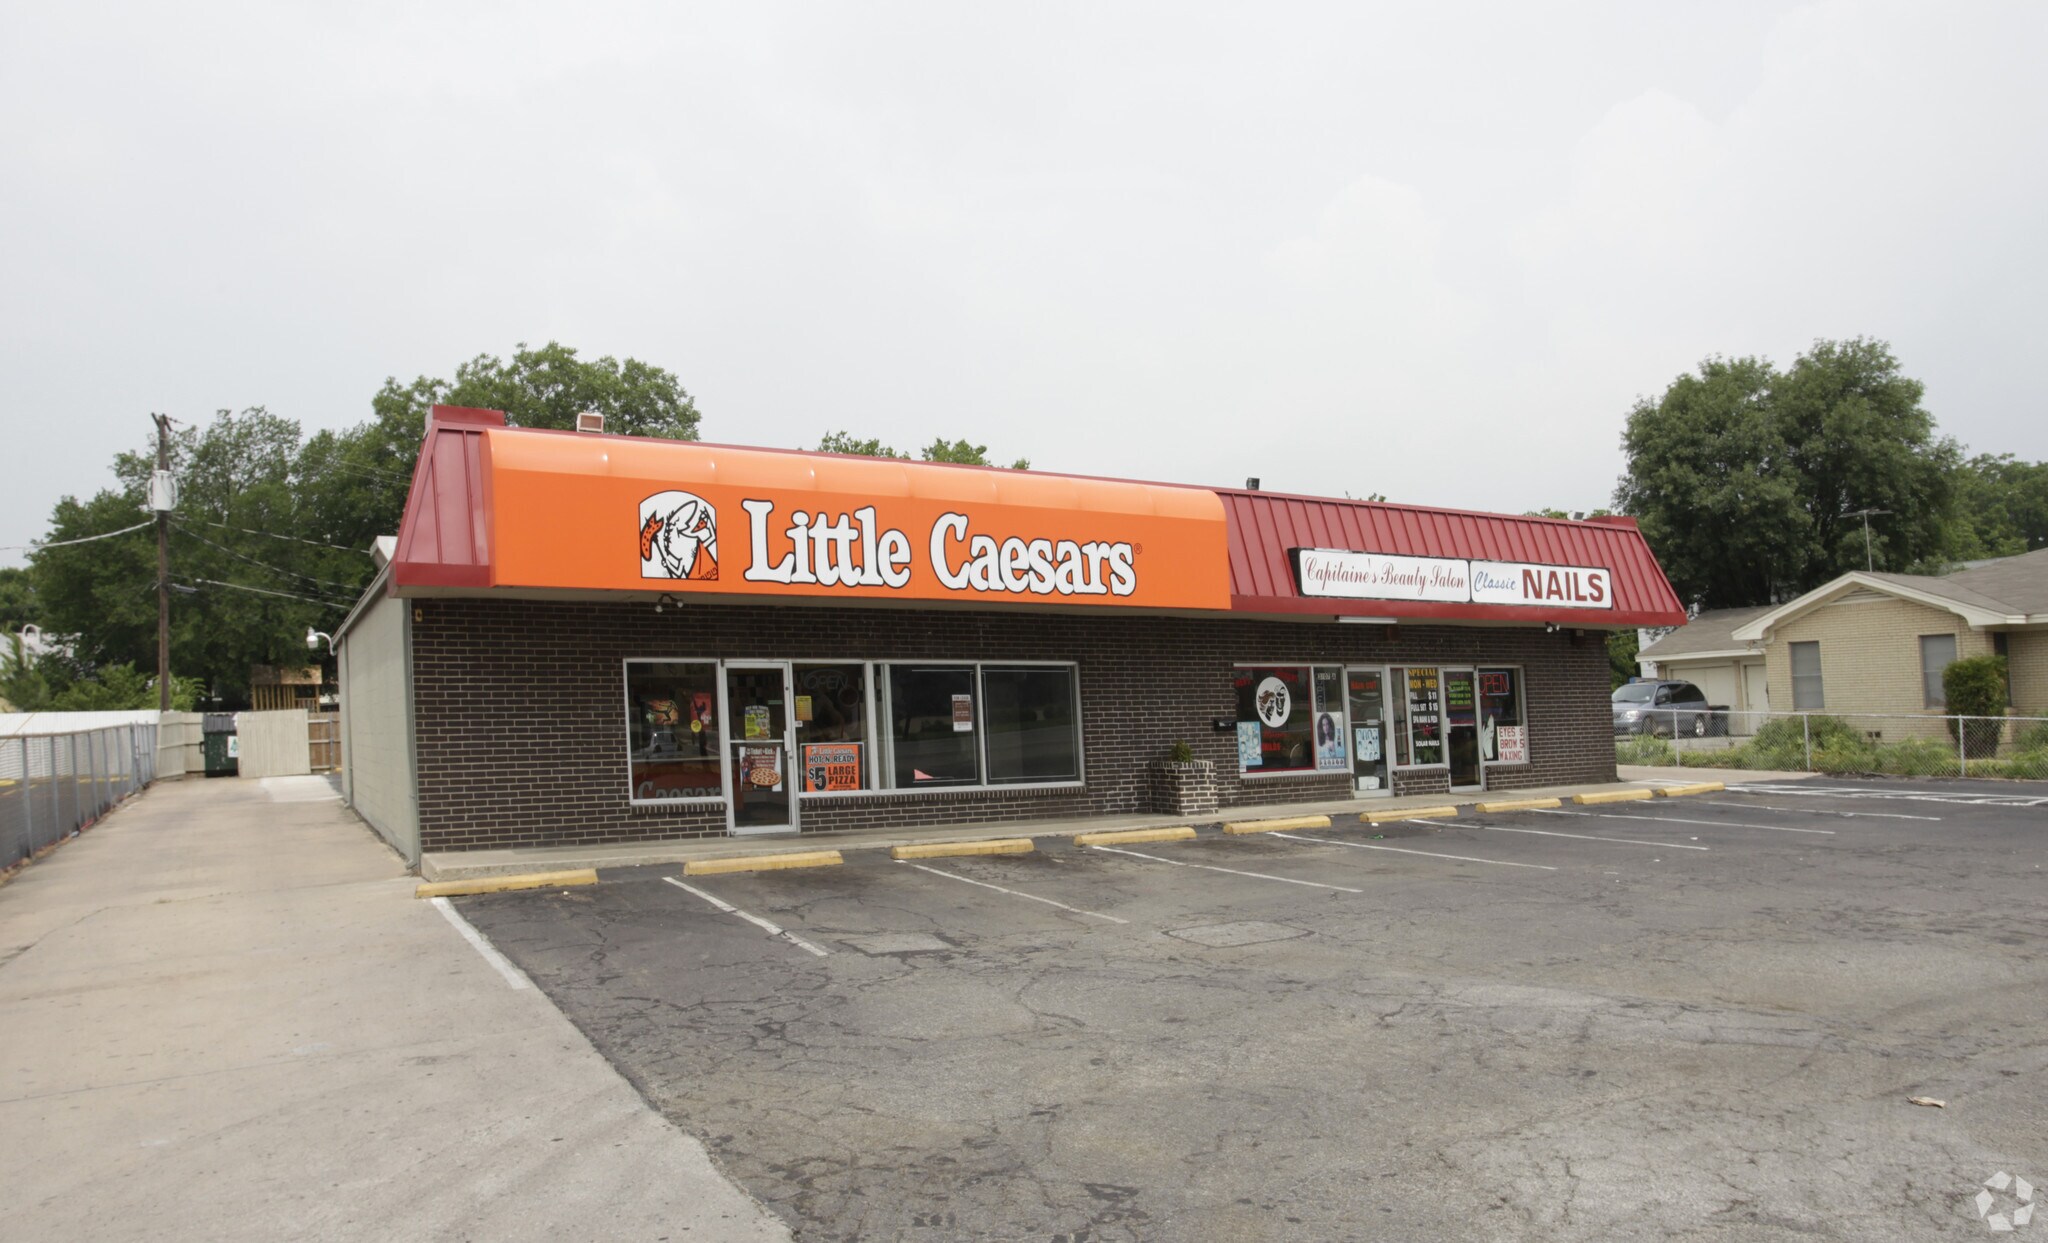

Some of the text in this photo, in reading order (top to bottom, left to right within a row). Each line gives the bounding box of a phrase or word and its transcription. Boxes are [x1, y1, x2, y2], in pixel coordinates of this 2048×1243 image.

[741, 498, 1138, 597] Little Caesars
[1381, 561, 1428, 596] Beauty
[1429, 564, 1466, 589] Salon
[1474, 568, 1605, 602] Classic NAILS
[1408, 668, 1437, 677] SPECIAL
[1409, 679, 1421, 689] MON
[1425, 679, 1438, 689] WED
[1478, 673, 1509, 693] OPEN
[1410, 704, 1420, 712] FULL
[833, 754, 856, 763] READY
[1499, 750, 1523, 761] WAXING
[828, 765, 856, 775] LARGE
[828, 775, 856, 785] PIZZA
